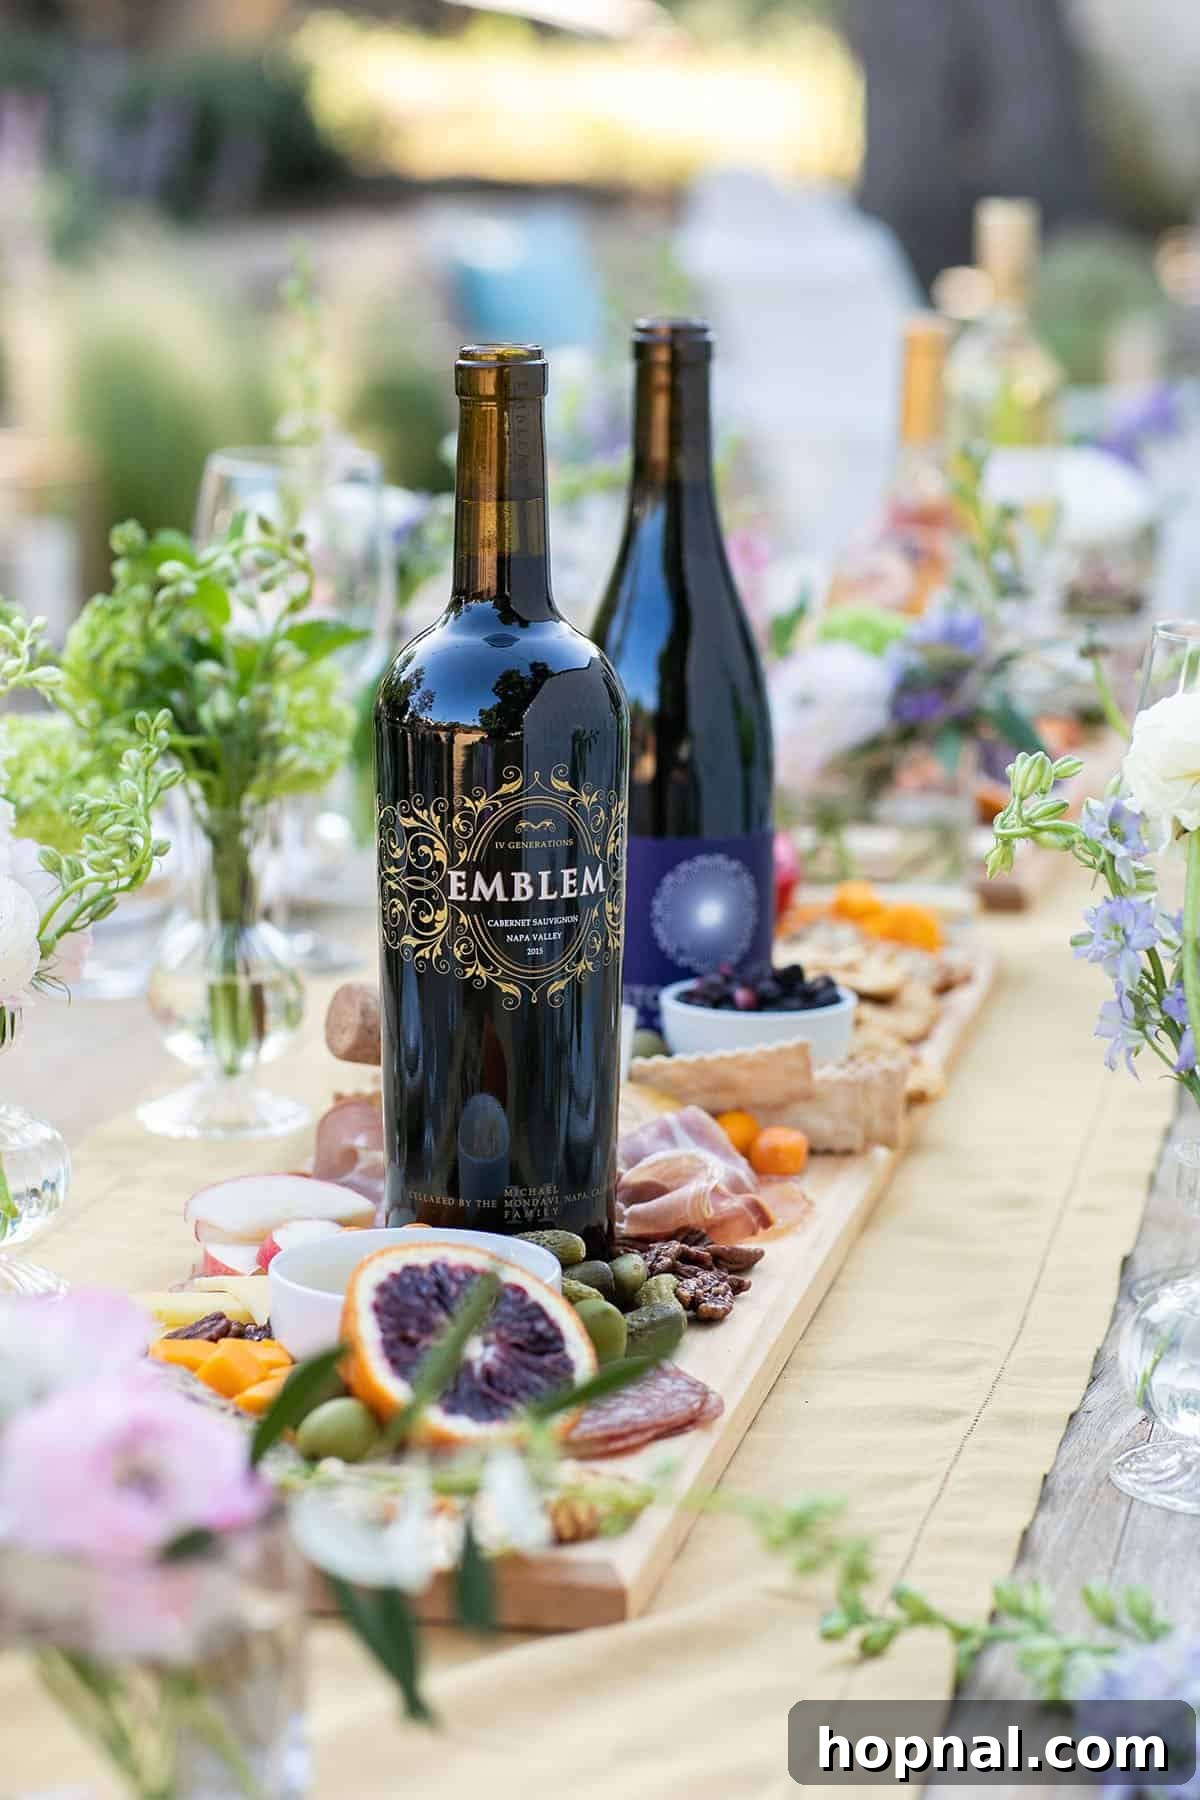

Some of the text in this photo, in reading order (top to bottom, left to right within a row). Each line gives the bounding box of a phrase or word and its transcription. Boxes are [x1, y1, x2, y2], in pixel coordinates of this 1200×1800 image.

[495, 838, 574, 850] IV GENERATIONS
[447, 863, 606, 902] EMBLEM
[487, 914, 579, 928] CABERNET SAUVIGNON
[506, 931, 563, 943] NAPA VALLEY
[504, 1184, 559, 1197] MICHAEL
[458, 1198, 472, 1208] BY
[476, 1199, 497, 1208] THE
[504, 1195, 559, 1208] MONDAVI
[504, 1207, 559, 1219] FAMILY
